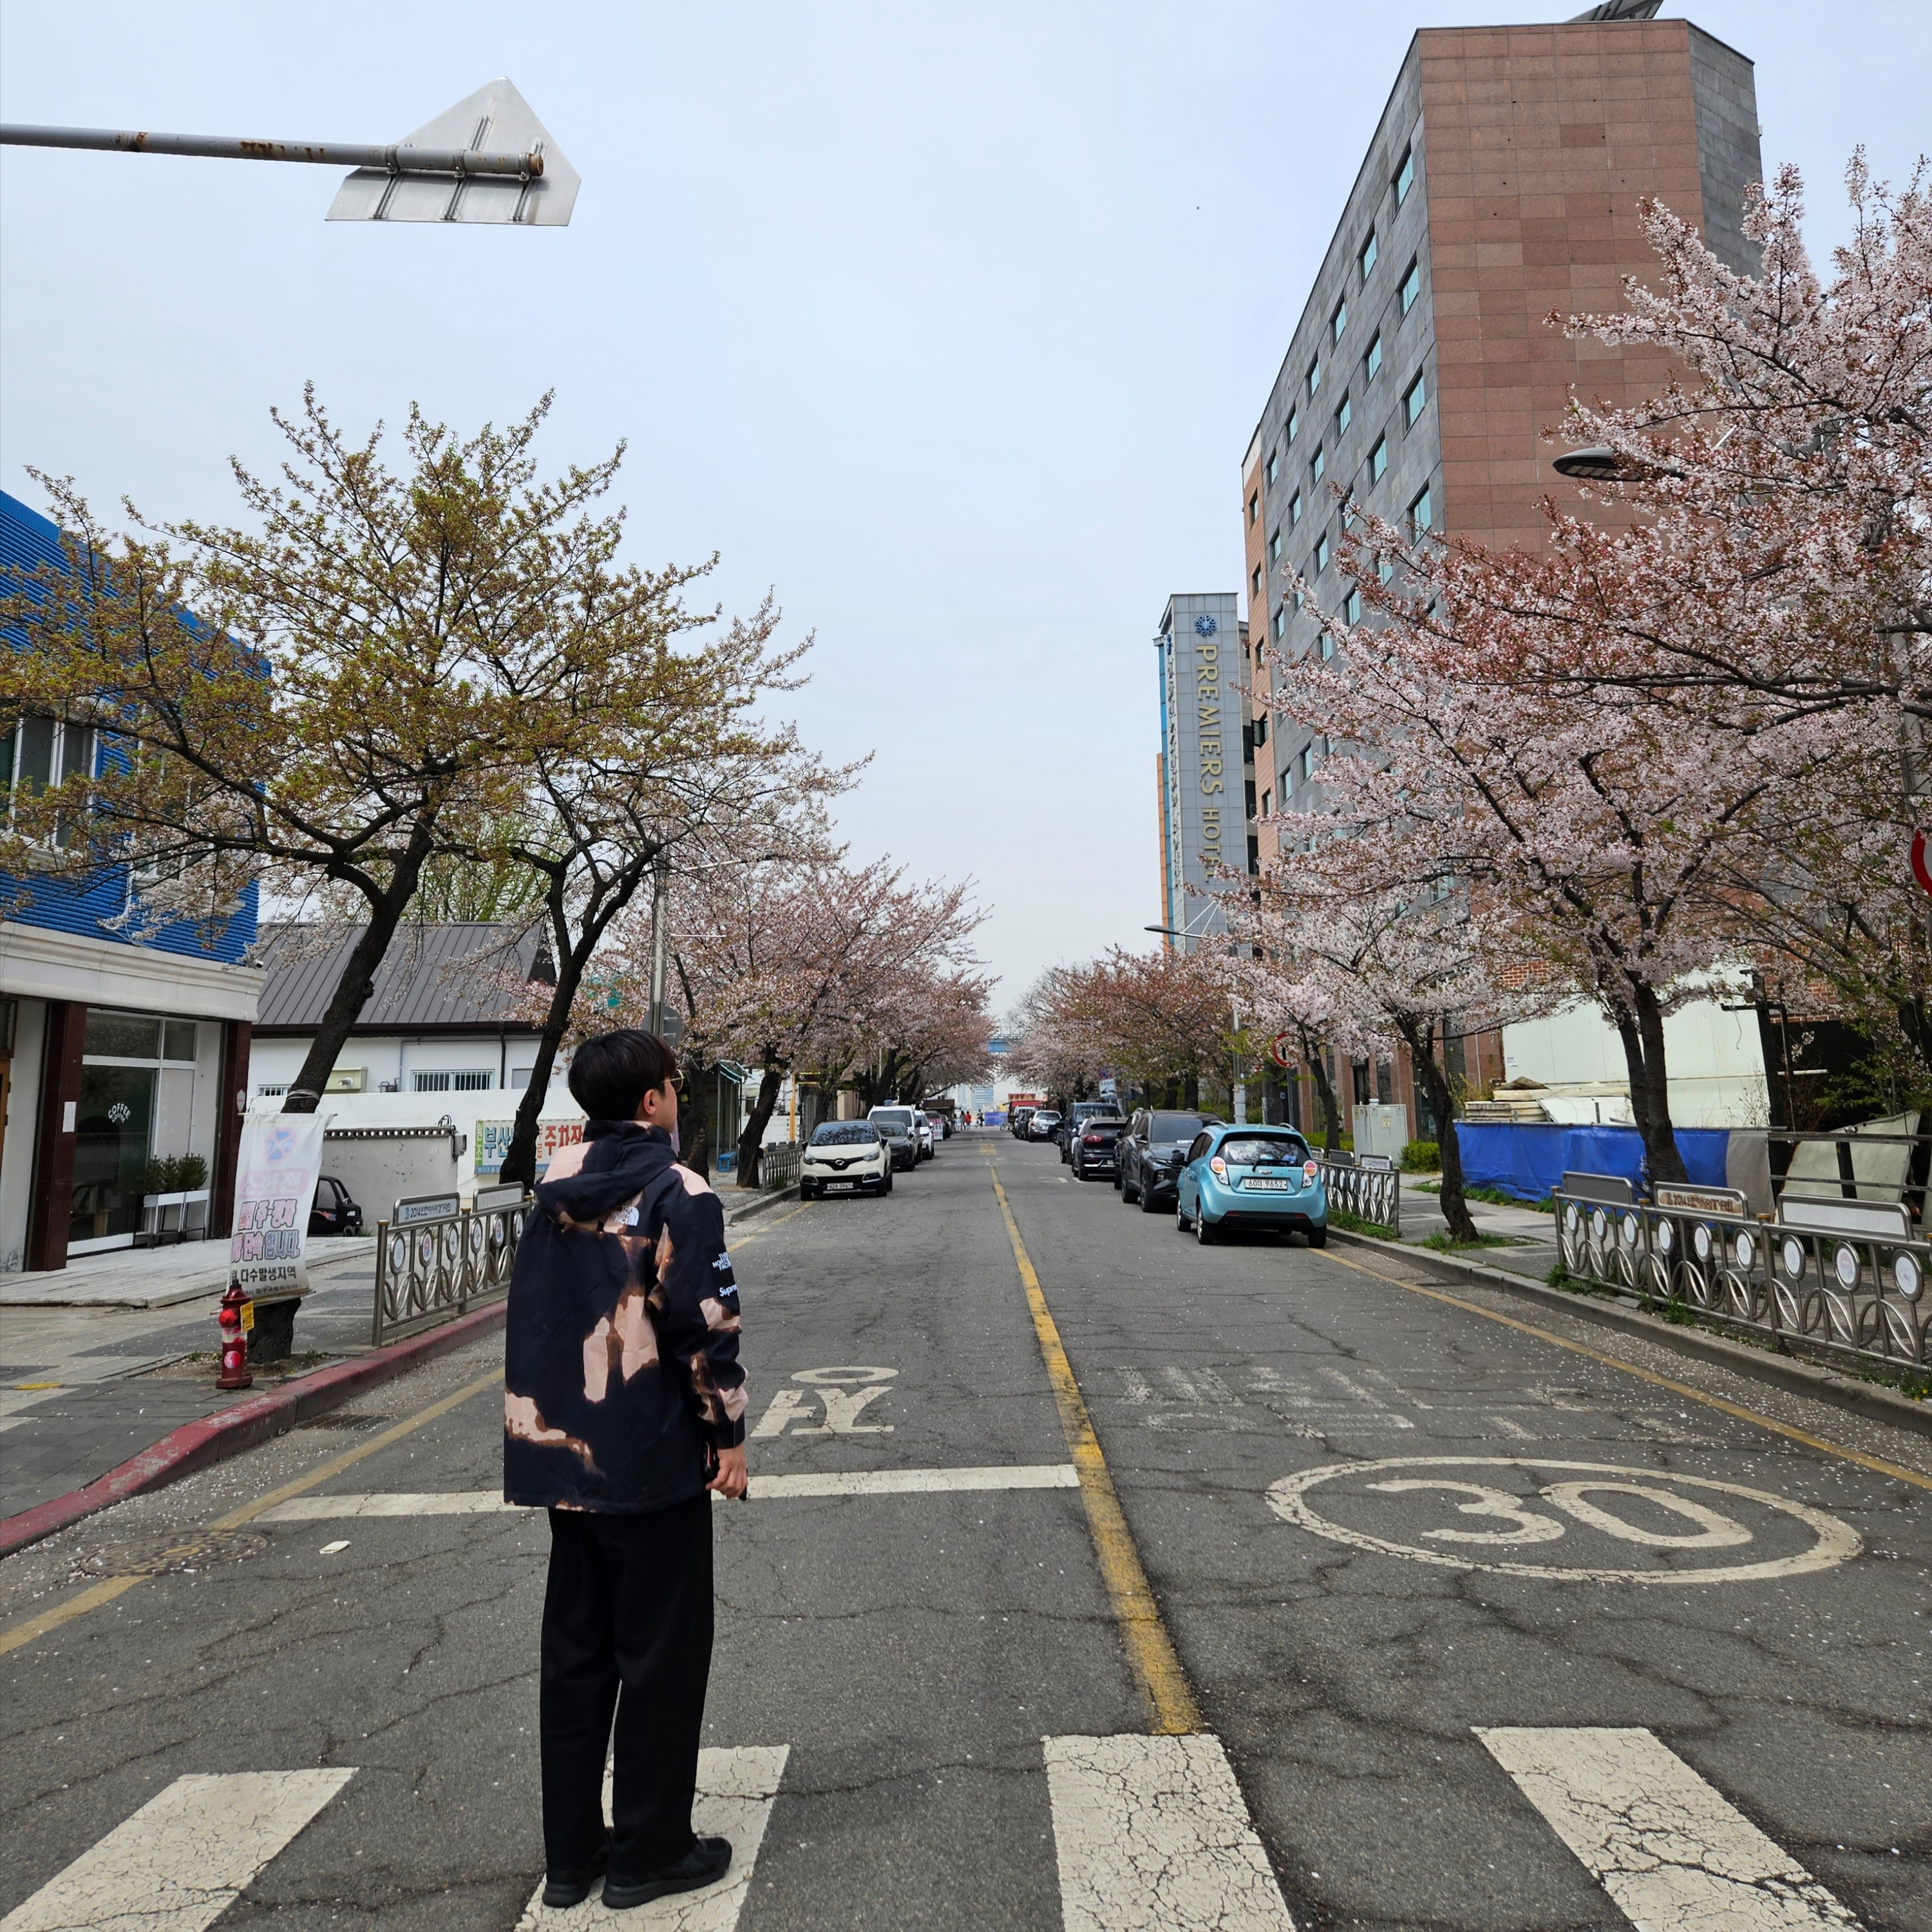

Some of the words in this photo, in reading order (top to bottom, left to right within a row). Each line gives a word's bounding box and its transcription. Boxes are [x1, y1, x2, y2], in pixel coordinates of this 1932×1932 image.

[1196, 644, 1223, 795] PREMIERS
[1202, 808, 1220, 884] HOTEL
[108, 1103, 131, 1120] COFFEE
[476, 1121, 483, 1160] 원조
[484, 1126, 515, 1158] 부산
[545, 1124, 583, 1155] 주차장
[241, 1266, 297, 1283] 다수발생지역
[1365, 1479, 1753, 1547] 30
